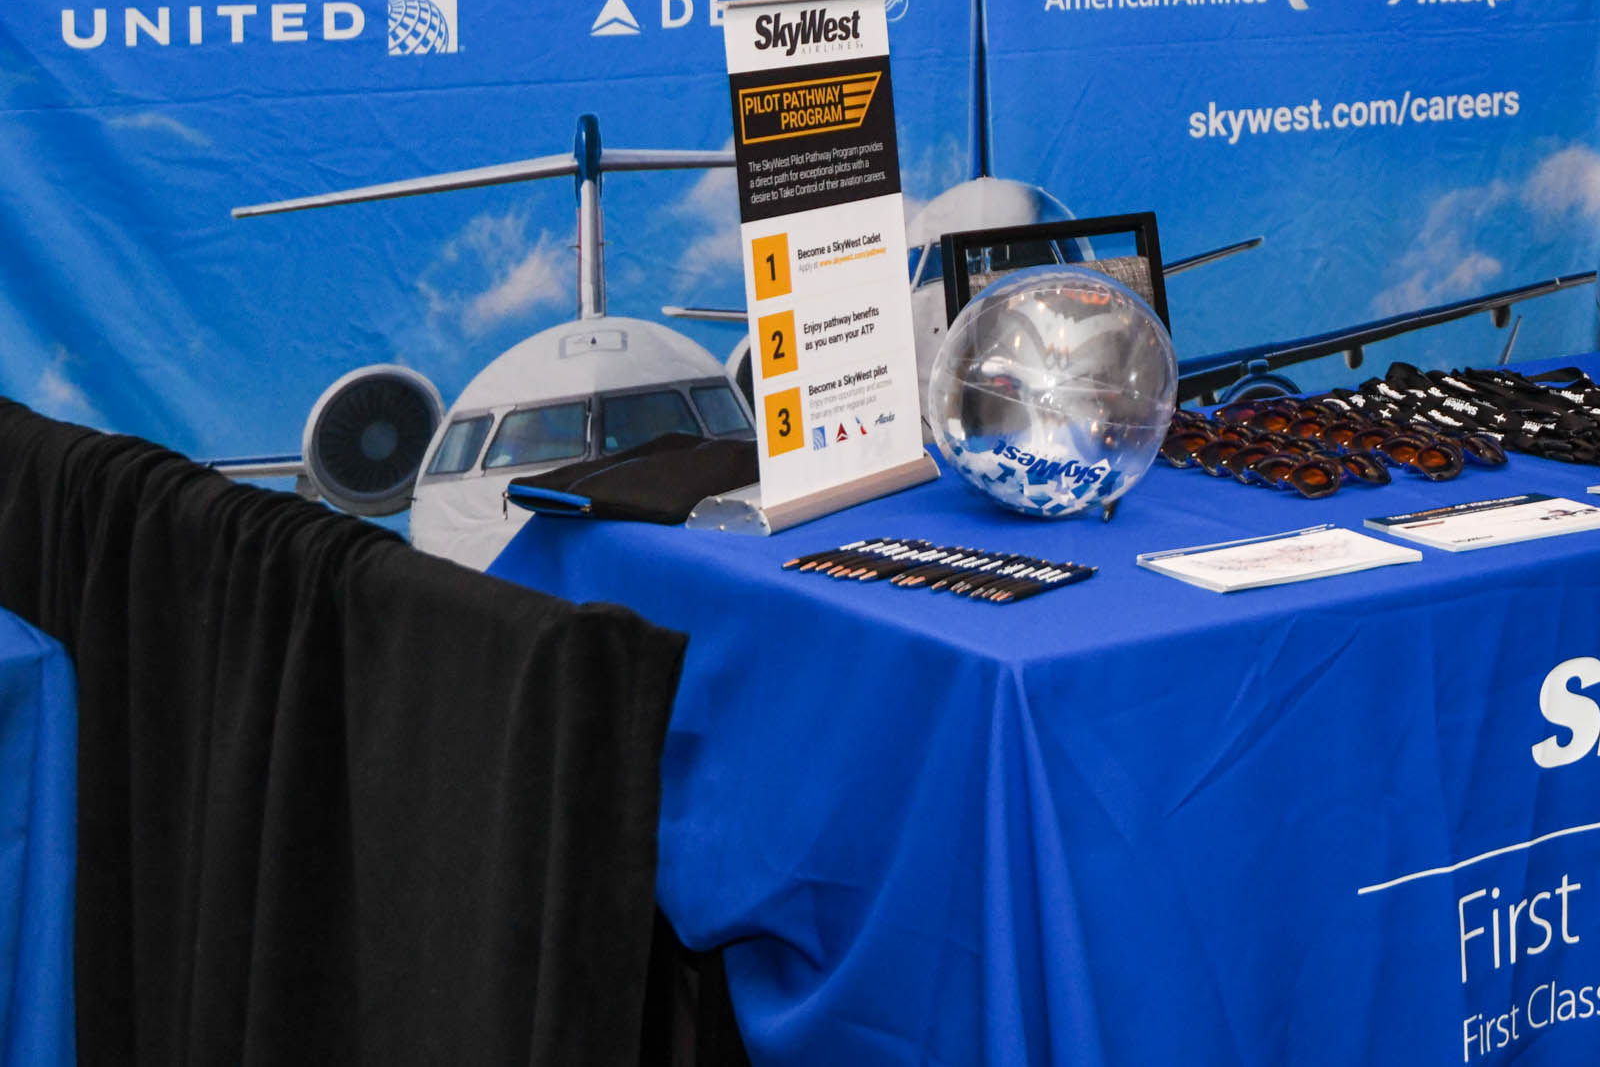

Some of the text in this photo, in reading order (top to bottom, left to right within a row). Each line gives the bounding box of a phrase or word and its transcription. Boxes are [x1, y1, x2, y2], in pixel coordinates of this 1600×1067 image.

[61, 2, 366, 49] UNITED
[754, 8, 861, 56] SkyWest
[801, 42, 861, 55] AIRLINES
[744, 85, 842, 115] PILOT PATHWAY
[781, 104, 843, 131] PROGRAM
[1189, 90, 1520, 144] skywest.com/careers
[748, 141, 884, 173] The SkyWest Pilot Pathway Program provides
[755, 175, 774, 188] direct
[774, 172, 789, 186] path
[789, 170, 799, 182] for
[799, 163, 834, 181] exceptional
[834, 161, 852, 175] pilots
[750, 191, 771, 205] desire
[771, 190, 779, 200] to
[778, 186, 795, 199] Take
[795, 181, 818, 196] Control
[797, 246, 826, 260] Become
[832, 237, 861, 253] SkyWest
[862, 232, 881, 245] Cadet
[766, 253, 776, 281] 1
[803, 306, 880, 335] Enjoy pathway benefits
[771, 330, 785, 360] 2
[805, 323, 875, 351] as you earn your ATP
[808, 381, 836, 396] Become
[843, 368, 872, 387] SkyWest
[873, 365, 888, 378] pilot
[778, 408, 791, 437] 3
[1458, 873, 1582, 983] First
[1463, 1004, 1520, 1063] First
